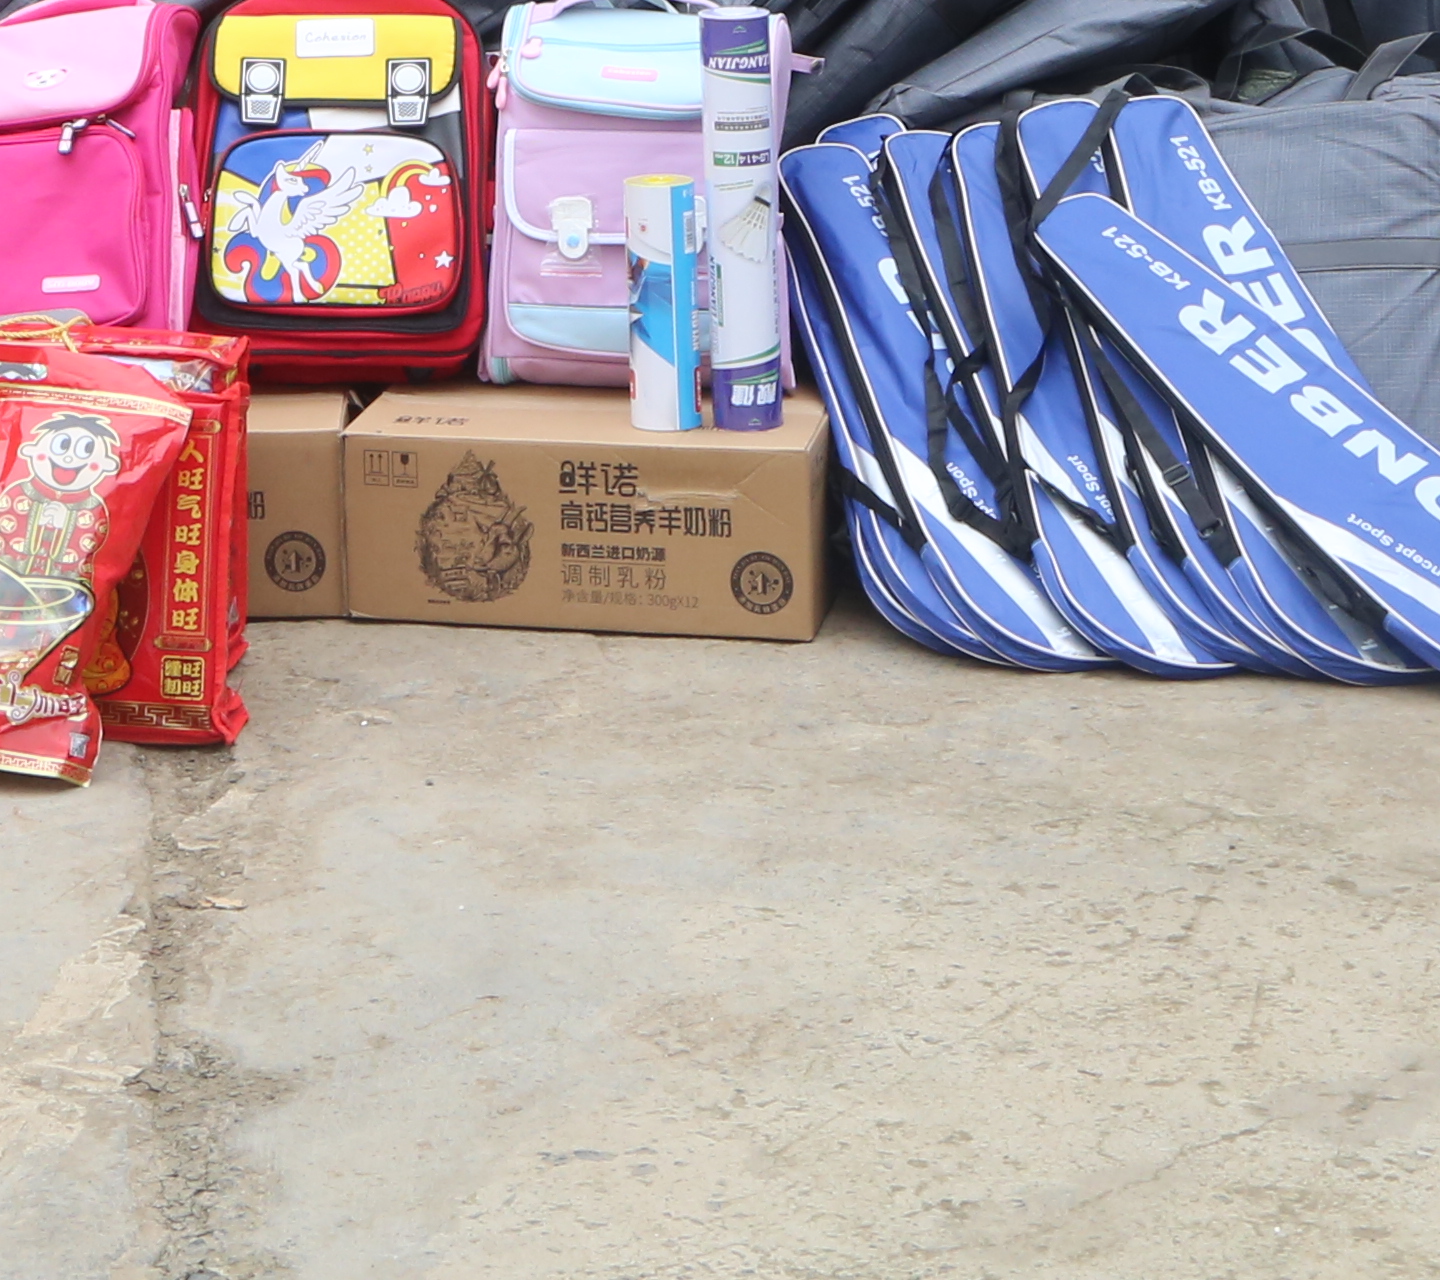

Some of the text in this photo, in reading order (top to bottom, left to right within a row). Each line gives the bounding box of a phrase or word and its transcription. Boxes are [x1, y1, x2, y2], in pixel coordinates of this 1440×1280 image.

[1100, 225, 1190, 291] KB-521
[558, 460, 639, 497] 鲜诺
[171, 438, 205, 631] 人旺气旺身体旺
[560, 502, 732, 538] 高钙营养羊奶粉
[560, 542, 666, 562] 新西兰进口奶源
[561, 564, 666, 590] 调制乳粉
